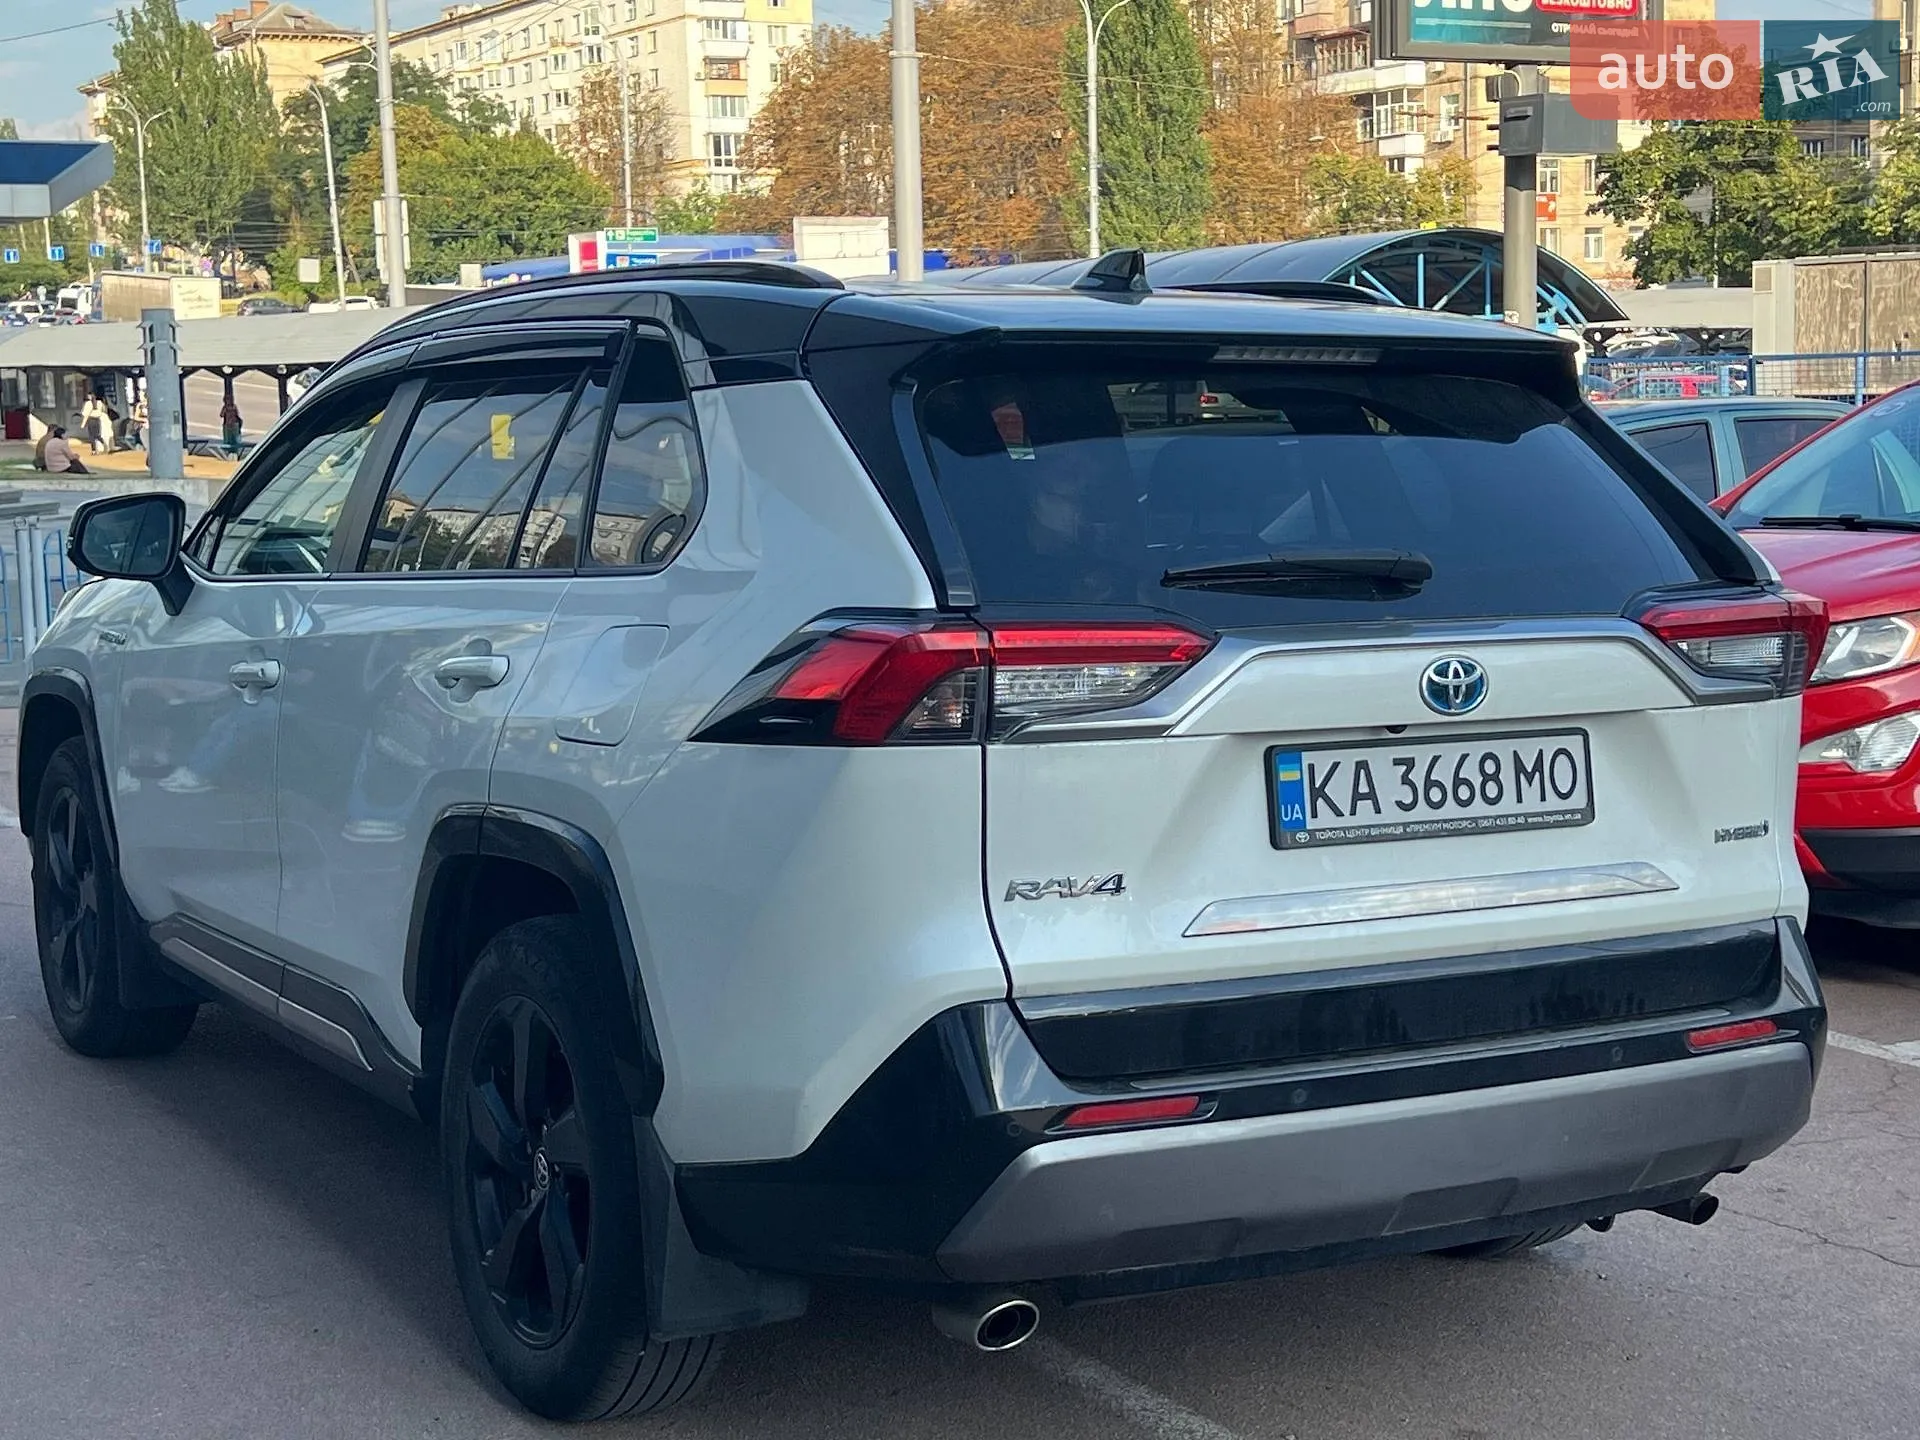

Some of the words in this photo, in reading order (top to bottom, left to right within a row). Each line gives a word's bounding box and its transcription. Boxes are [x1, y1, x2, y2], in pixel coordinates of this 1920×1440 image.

[1308, 759, 1382, 819] KA
[1392, 751, 1504, 811] 3668
[1512, 747, 1577, 804] MO
[1281, 803, 1303, 822] UA
[1003, 871, 1127, 902] RAV4
